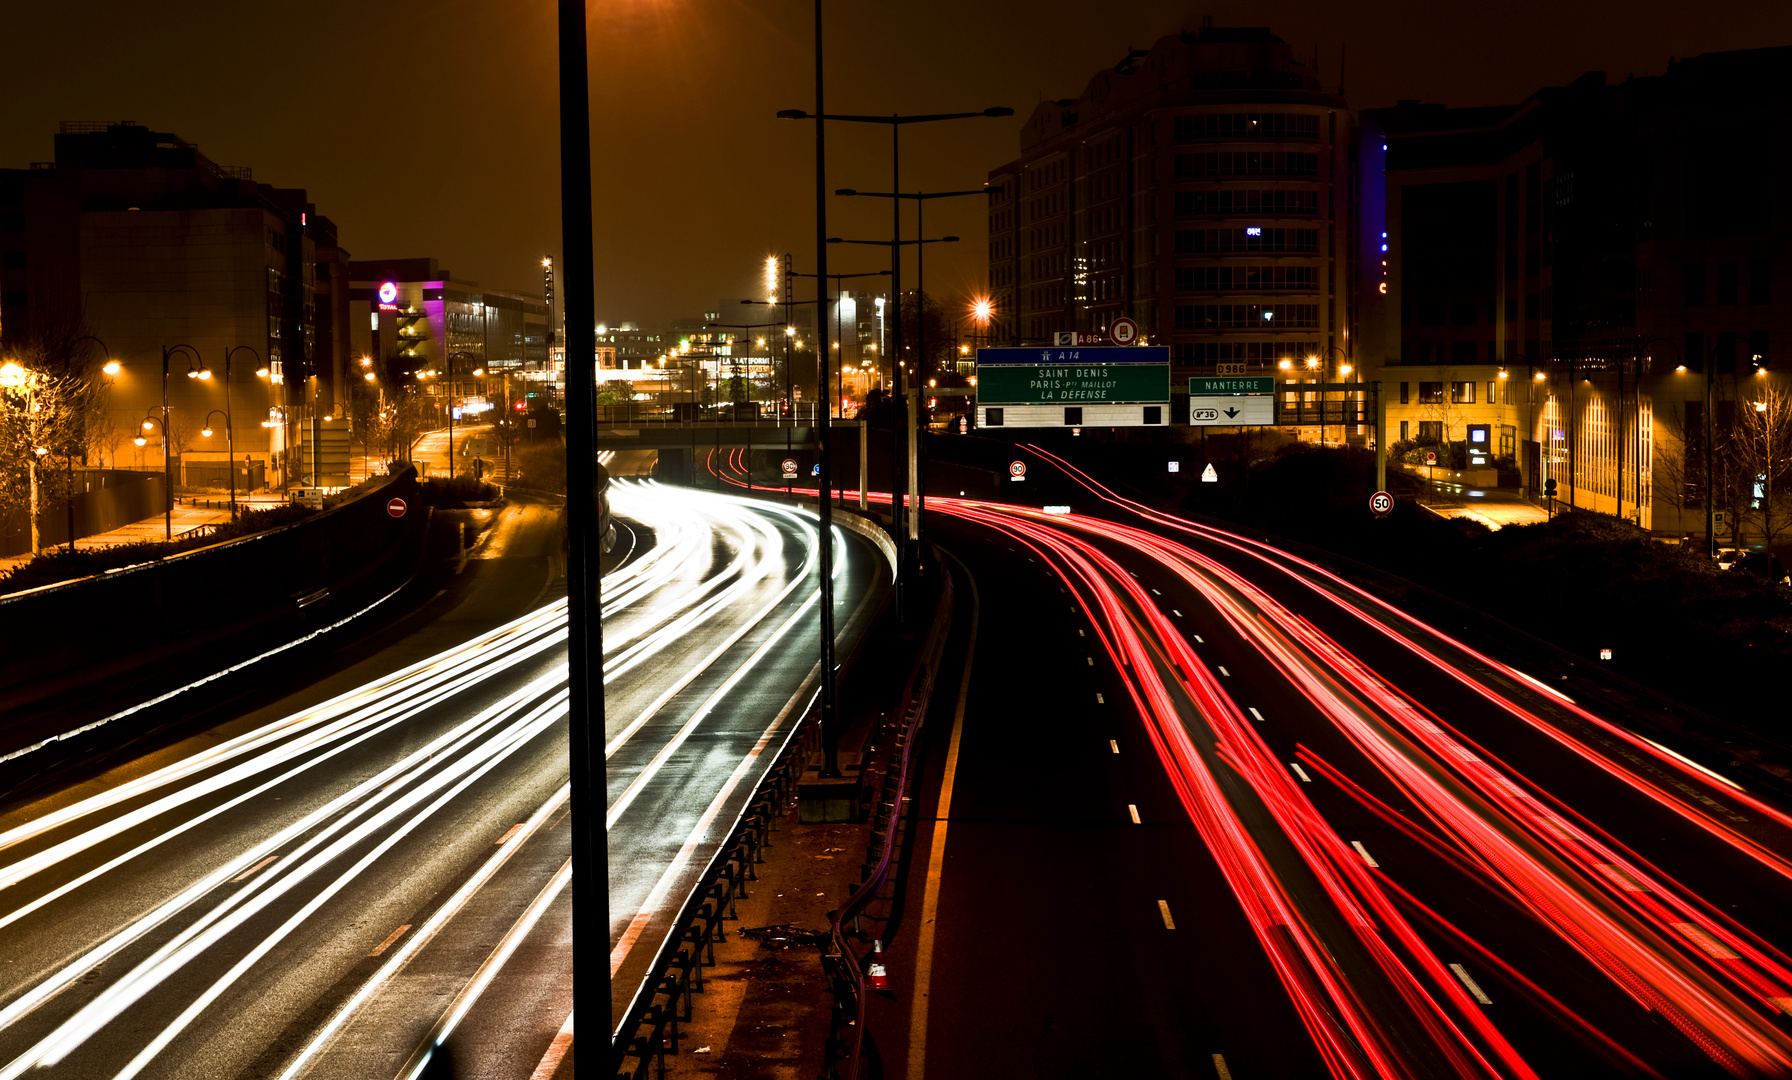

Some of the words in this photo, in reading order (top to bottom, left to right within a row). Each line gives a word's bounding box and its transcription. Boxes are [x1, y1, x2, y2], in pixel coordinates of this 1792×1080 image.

[1078, 334, 1084, 343] A
[1086, 334, 1099, 343] 86
[1058, 351, 1065, 360] A
[1069, 351, 1080, 360] 14
[1038, 369, 1069, 378] SAINT
[1076, 368, 1108, 378] DENIS
[1217, 365, 1224, 373] D
[1225, 365, 1245, 373] 986
[1081, 380, 1117, 388] MAILLOT
[1205, 380, 1259, 390] NANTERRE
[1041, 390, 1053, 399] LA
[1060, 388, 1107, 399] DÉFENSE
[785, 462, 795, 470] 90
[1013, 465, 1023, 473] 90
[1375, 499, 1389, 508] 50
